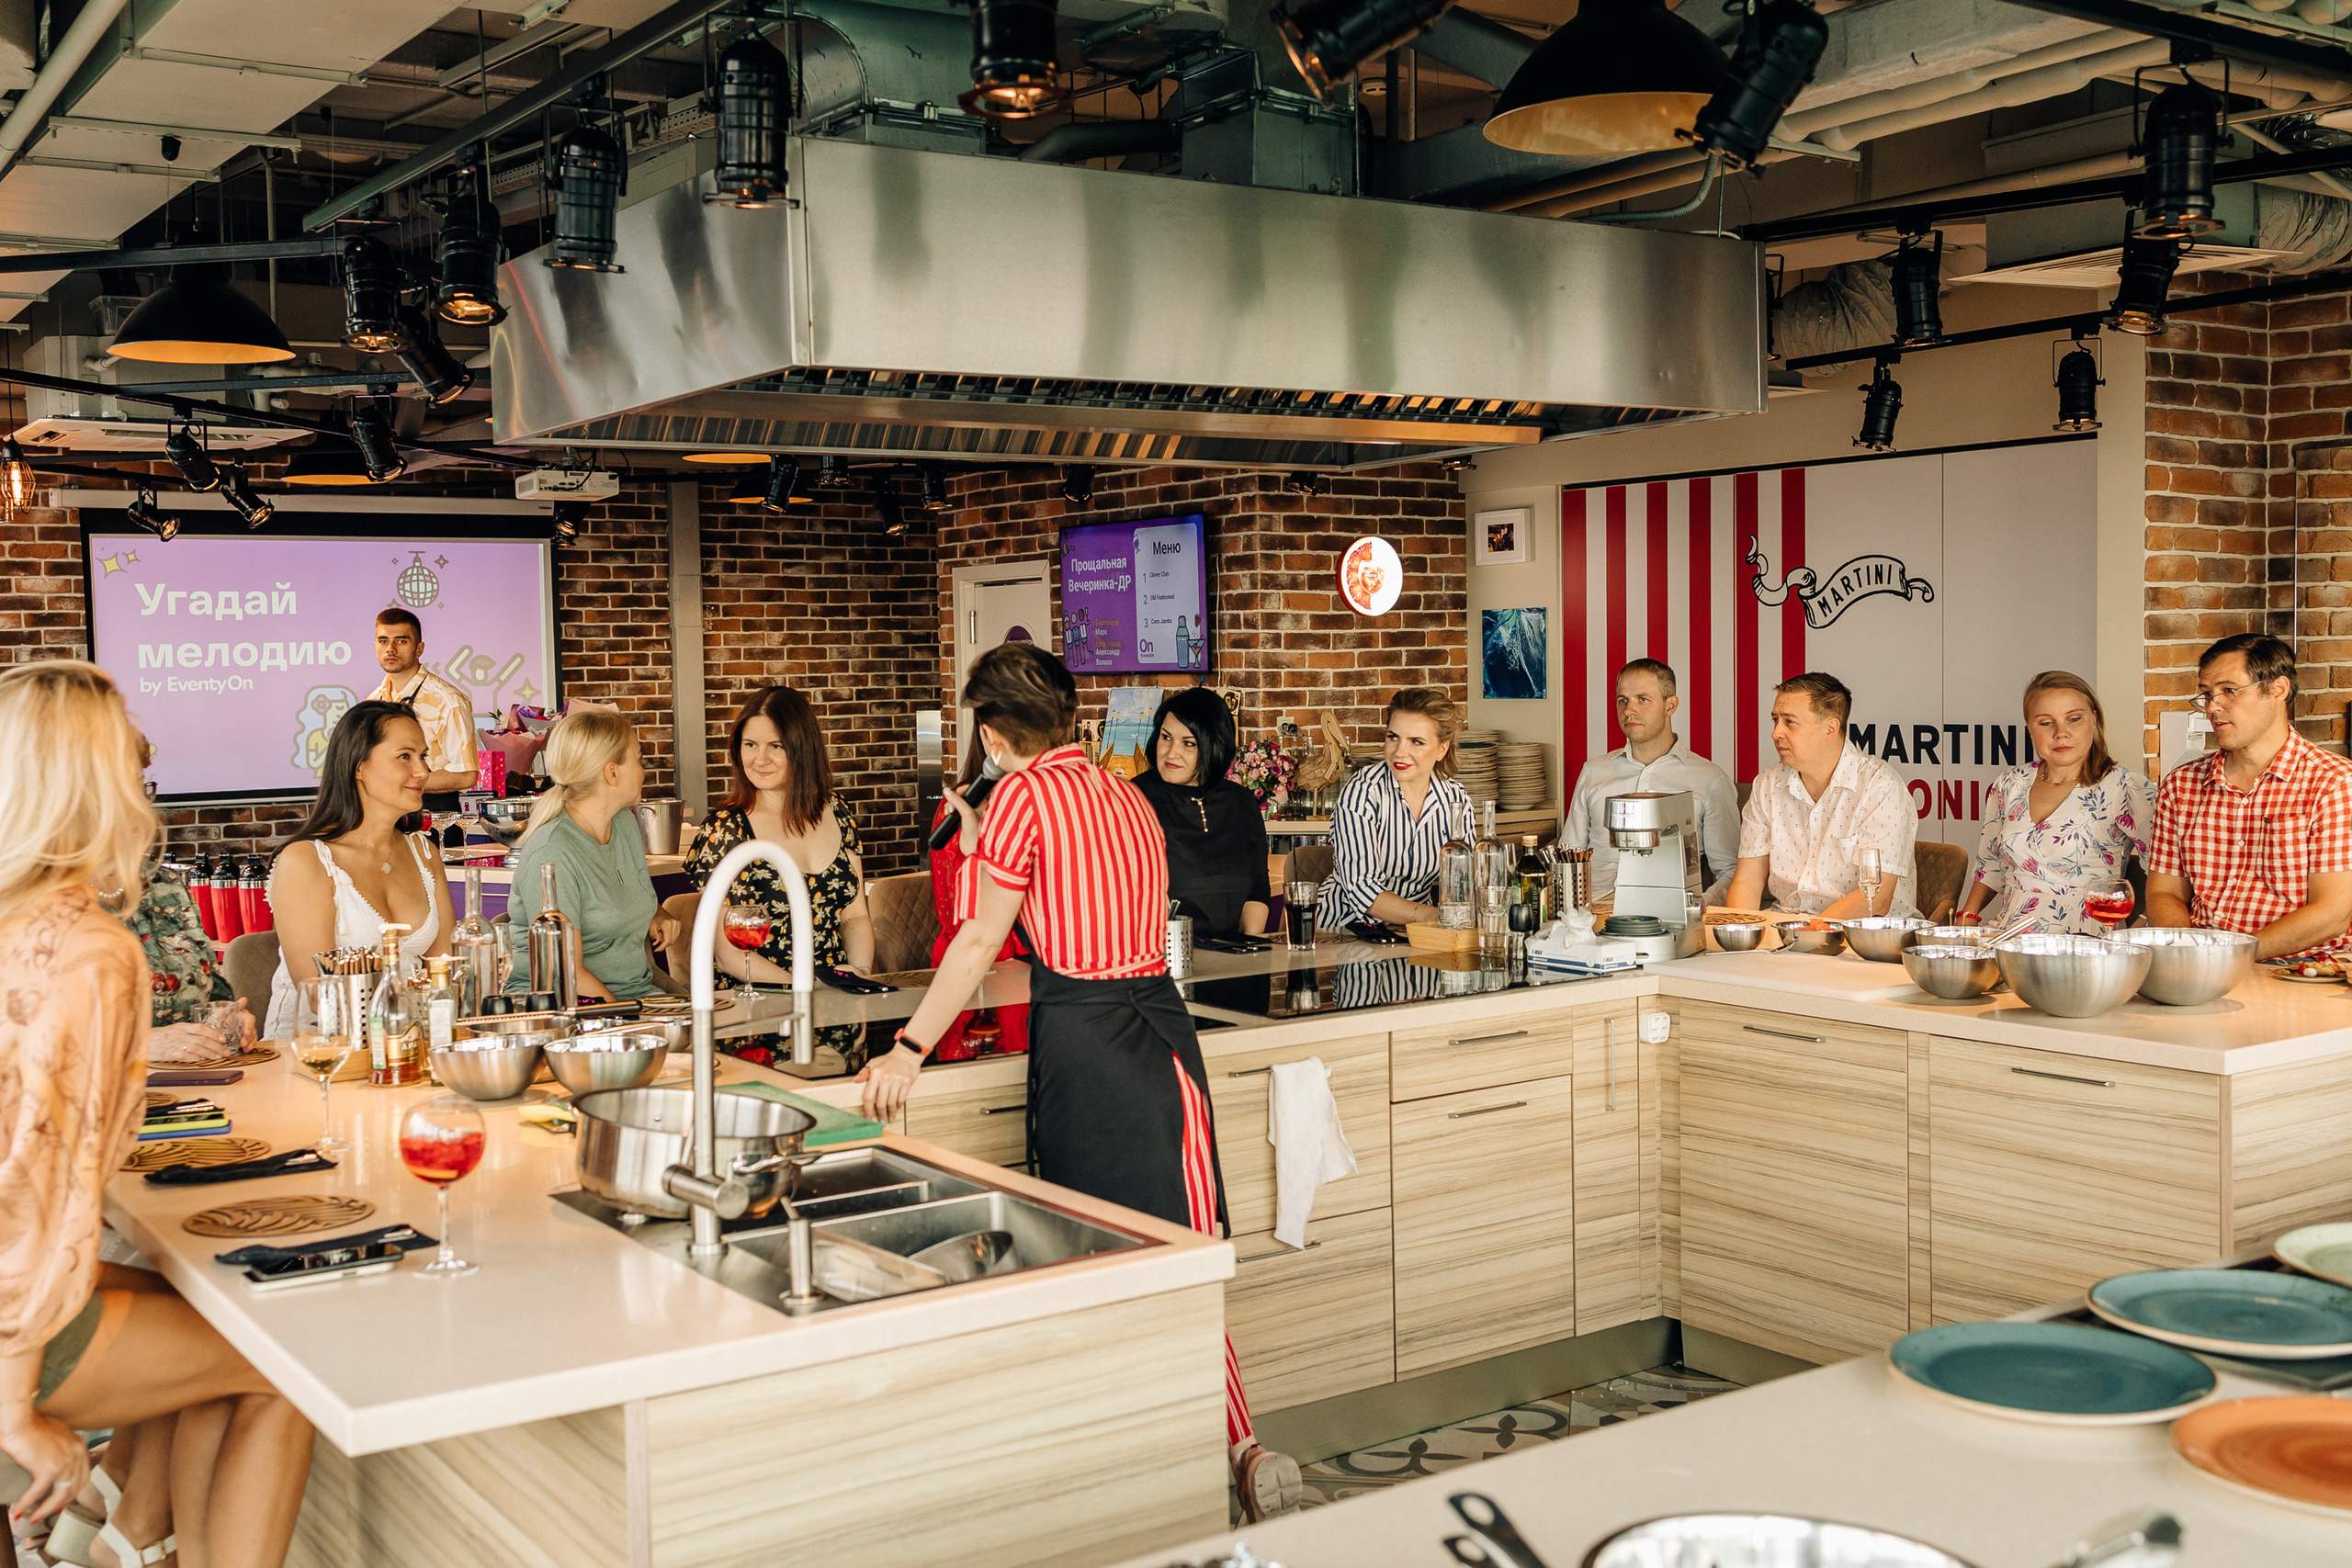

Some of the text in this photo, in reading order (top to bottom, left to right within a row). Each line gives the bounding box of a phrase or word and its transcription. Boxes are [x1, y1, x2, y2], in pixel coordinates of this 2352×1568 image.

[1153, 541, 1182, 555] Меню
[1071, 558, 1127, 575] Прощальная
[1068, 575, 1132, 594] Вечеринка-ДР
[1143, 572, 1147, 583] 1
[1143, 594, 1148, 604] 2
[1816, 564, 1894, 618] MARTINI
[134, 581, 298, 622] Угадай
[1144, 618, 1148, 628] 3
[1139, 638, 1154, 653] On
[138, 641, 352, 671] мелодию
[140, 674, 254, 696] by EventyOn
[1907, 779, 1994, 821] ONI
